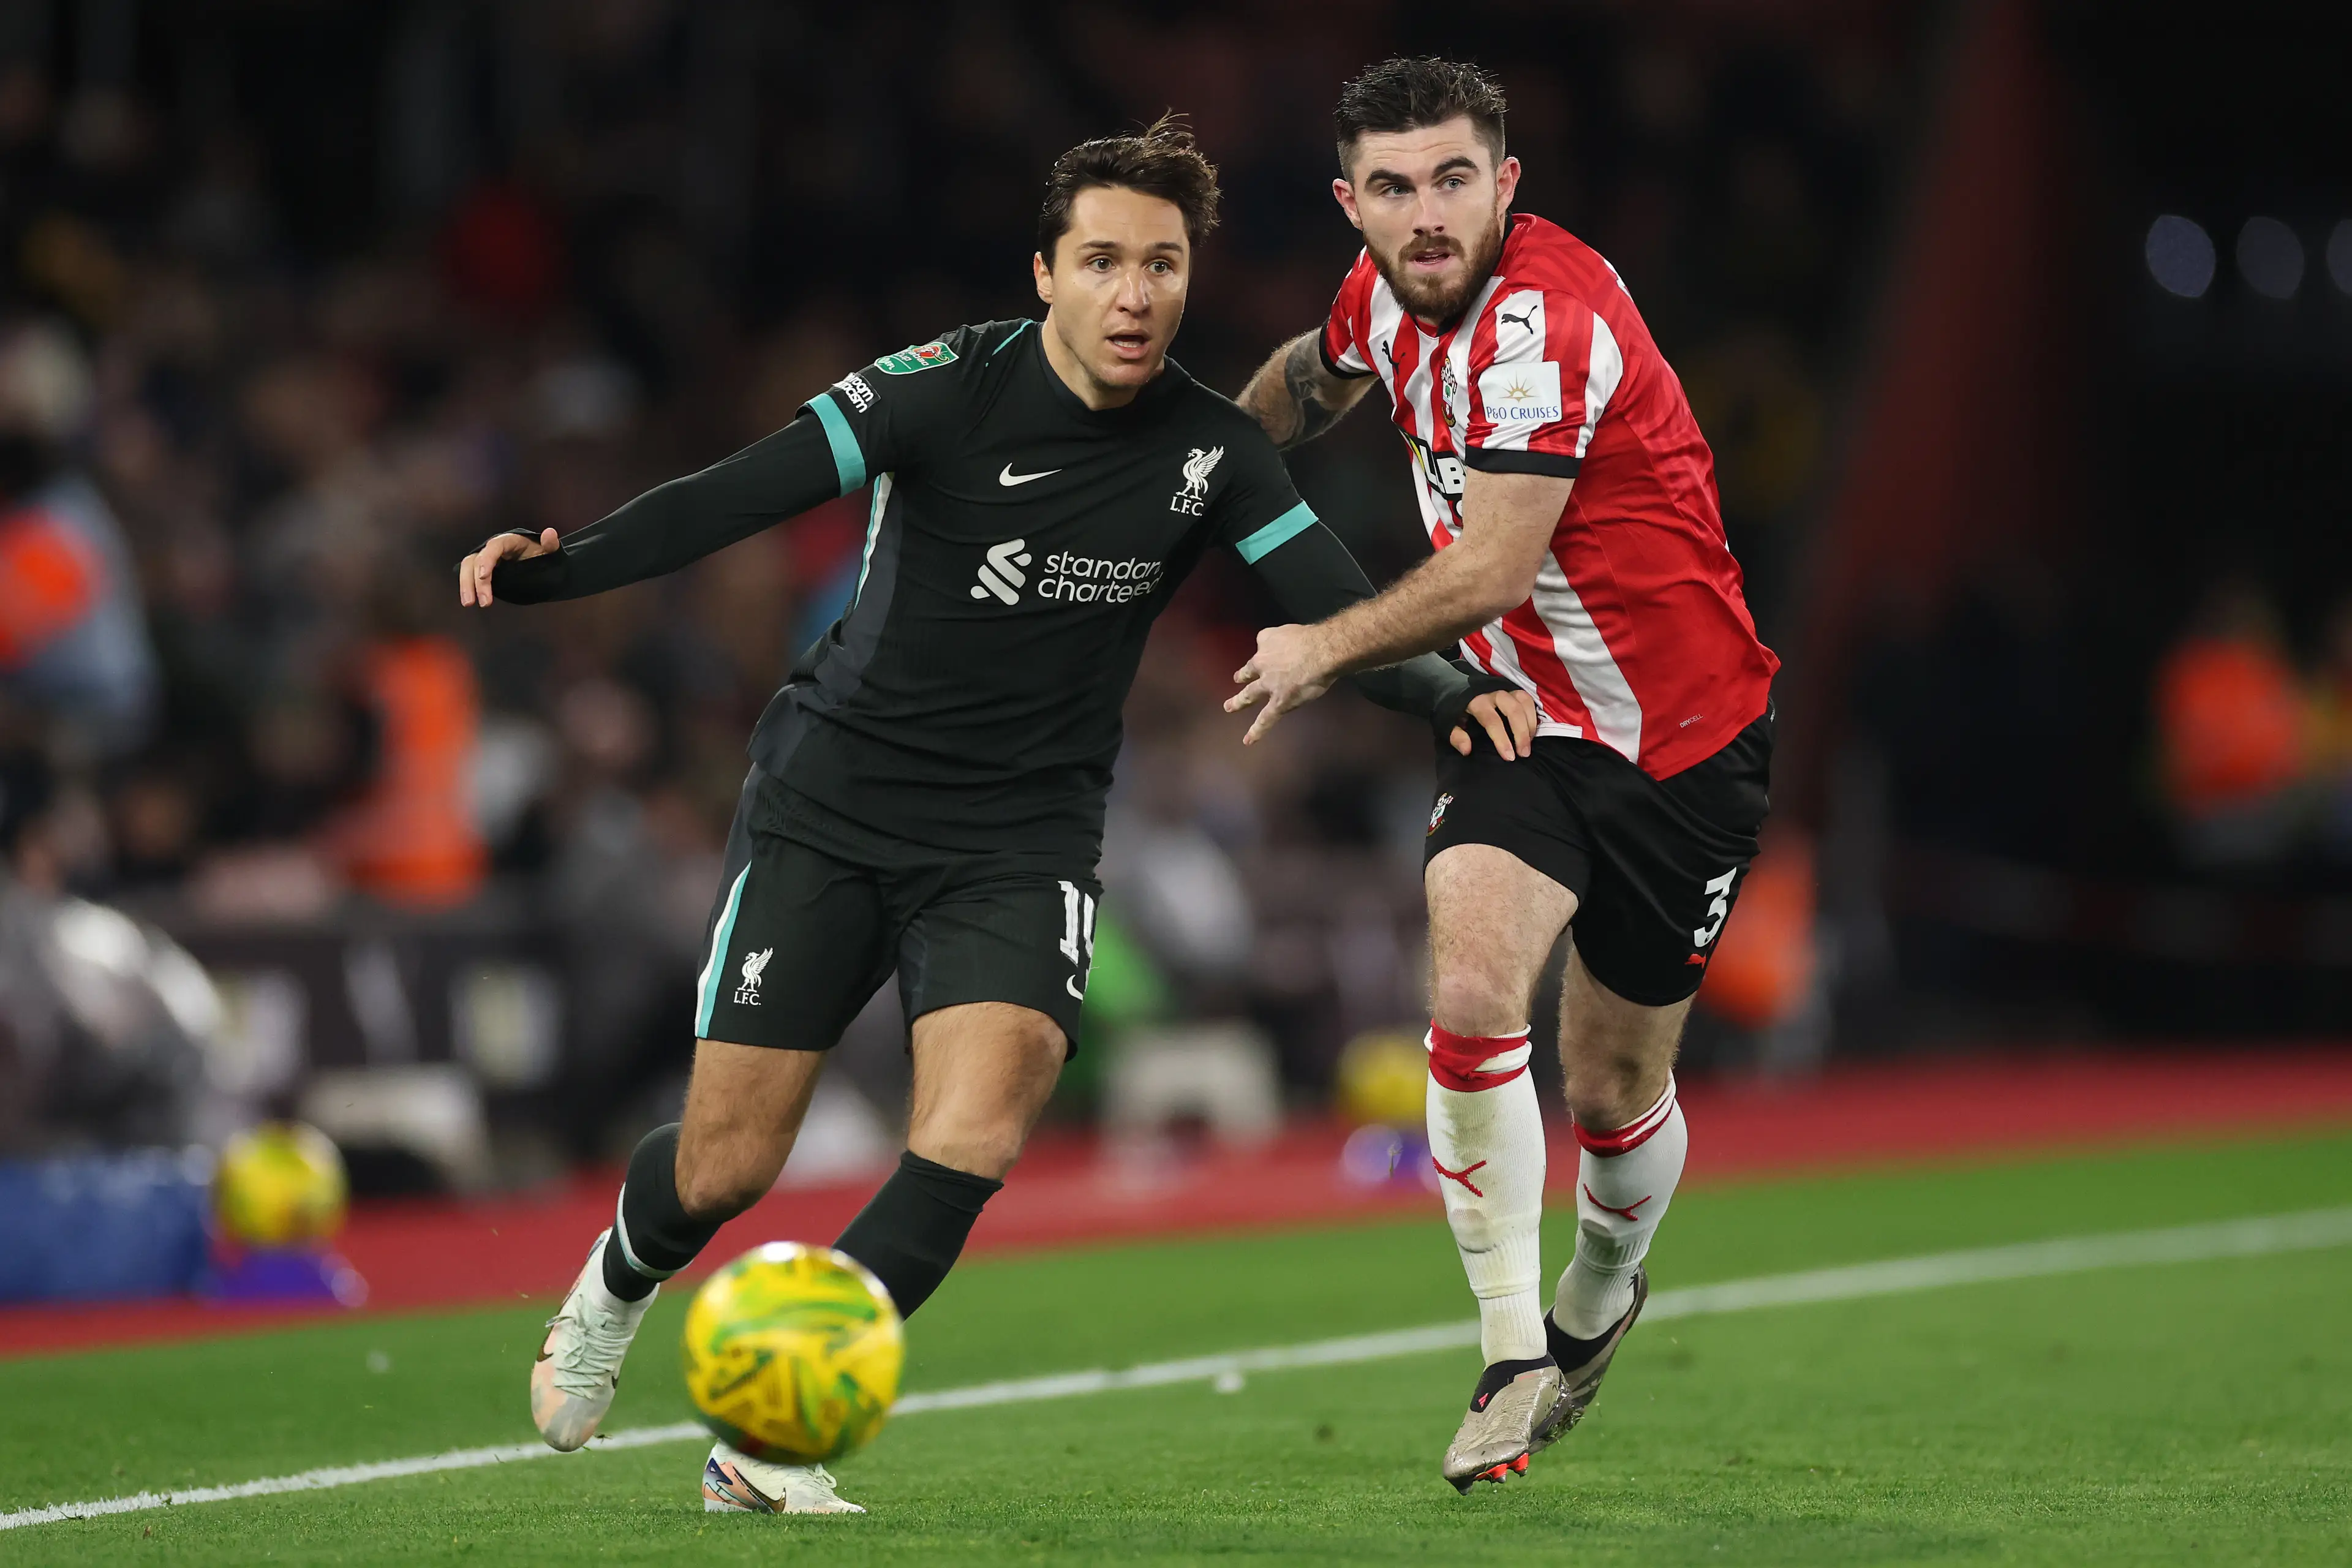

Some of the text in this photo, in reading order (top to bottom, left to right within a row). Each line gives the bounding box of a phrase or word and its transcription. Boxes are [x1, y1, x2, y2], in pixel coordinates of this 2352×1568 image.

[1487, 406, 1558, 420] P&O CRUISES
[1170, 496, 1204, 516] L.F.C.
[1044, 551, 1162, 579] standar
[1679, 714, 1703, 728] DRYCELL
[1694, 866, 1736, 947] 3
[734, 991, 761, 1006] L.F.C.
